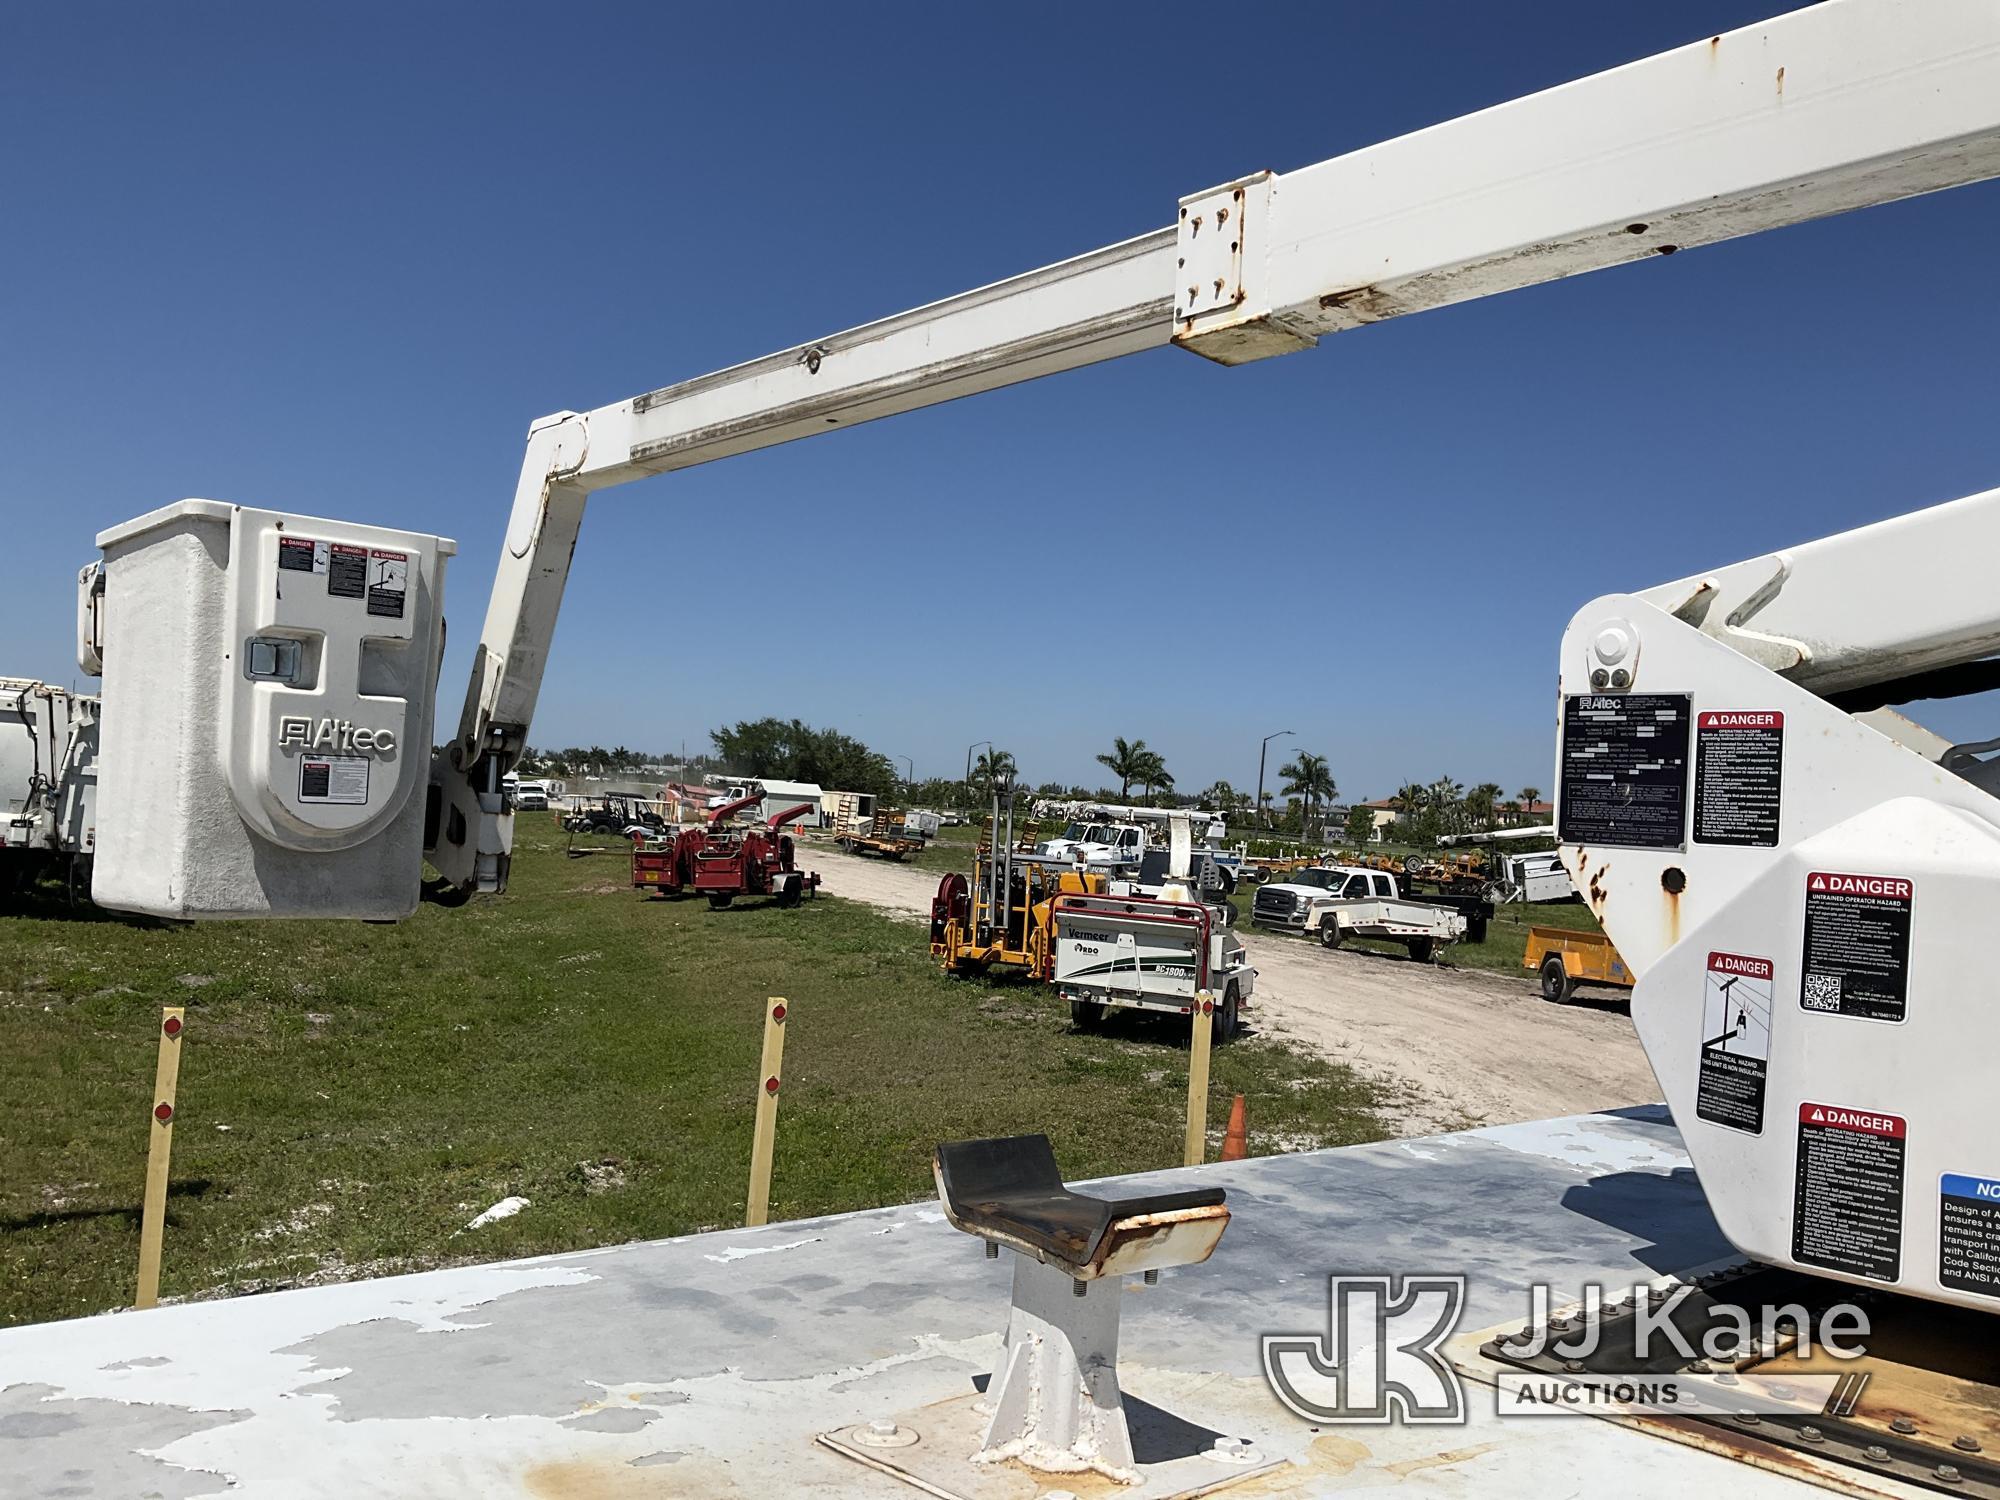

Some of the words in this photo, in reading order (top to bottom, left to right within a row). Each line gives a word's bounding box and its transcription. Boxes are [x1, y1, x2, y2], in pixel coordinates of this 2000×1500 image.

[1592, 697, 1621, 709] Altec
[1720, 715, 1774, 724] DANGER
[312, 718, 394, 750] Altec
[1830, 877, 1908, 896] DANGER
[1844, 896, 1875, 904] OPERATOR
[1068, 928, 1109, 940] Vermeer
[1725, 958, 1768, 975] DANGER
[1709, 1052, 1736, 1063] ELECTRICAL
[1738, 1059, 1757, 1068] HAZARD
[1711, 1060, 1721, 1068] UNIT
[1727, 1064, 1737, 1072] NON
[1738, 1066, 1765, 1078] INSULATING
[1827, 1110, 1894, 1132] DANGER
[1824, 1127, 1854, 1136] OPERATING
[1944, 1202, 1978, 1216] Design
[1981, 1209, 1991, 1217] of
[1944, 1214, 1983, 1227] ensures
[1944, 1225, 1982, 1238] remains
[1944, 1235, 1988, 1250] transport
[1990, 1242, 2000, 1252] in
[1944, 1246, 1963, 1256] with
[1966, 1250, 2000, 1262] Califor
[1944, 1256, 1970, 1268] Code
[1944, 1268, 1962, 1278] and
[1964, 1270, 1990, 1282] ANSI
